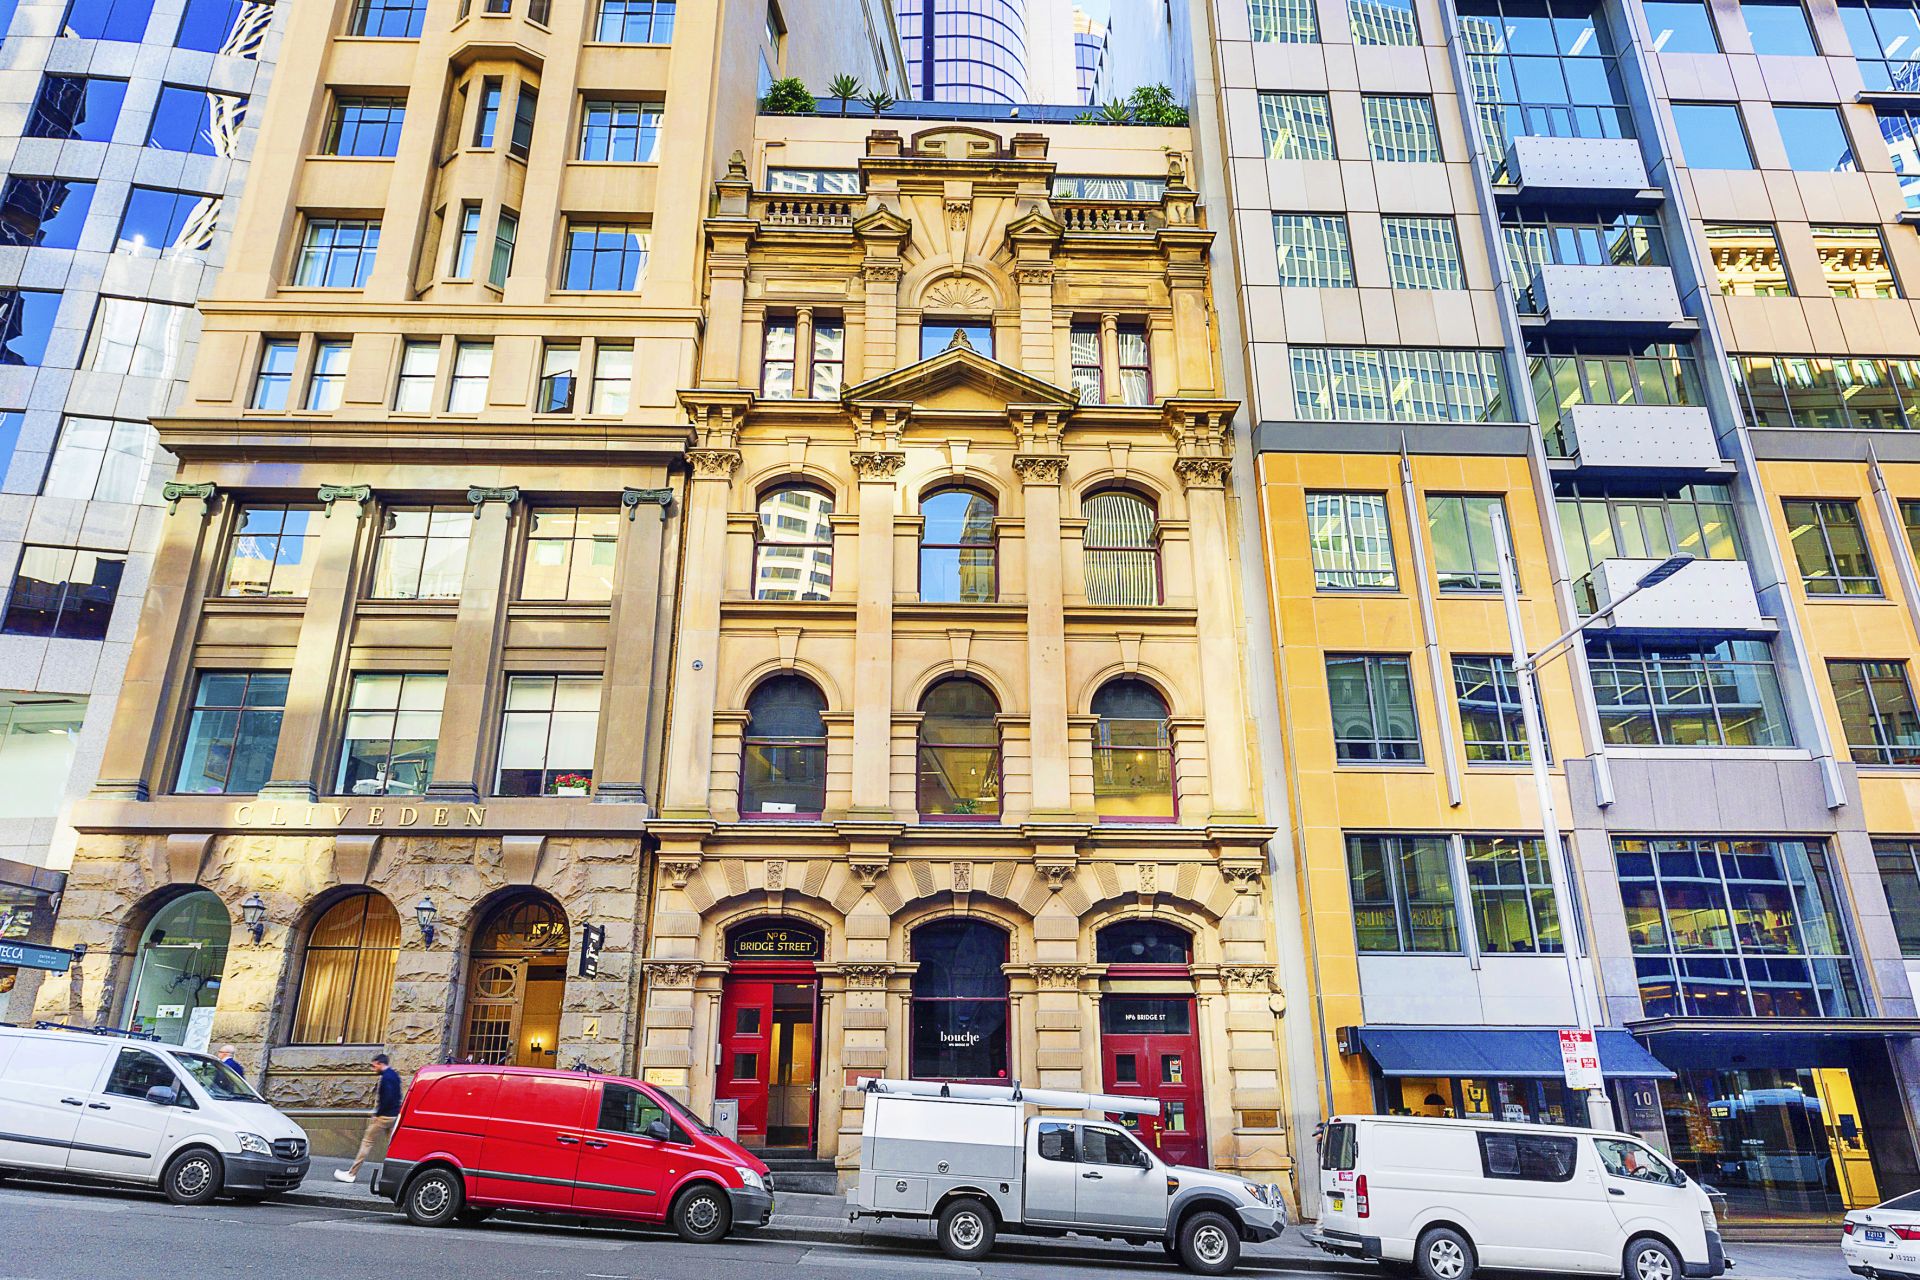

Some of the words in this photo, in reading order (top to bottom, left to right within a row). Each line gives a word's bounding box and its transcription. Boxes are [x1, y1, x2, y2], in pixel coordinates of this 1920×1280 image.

[234, 807, 486, 826] CLIVEDEN
[780, 932, 787, 941] 6
[740, 941, 774, 951] BRIDGE
[777, 941, 811, 951] STREET
[583, 1018, 598, 1039] 4
[940, 1030, 980, 1046] bouche
[1633, 1091, 1652, 1106] 10
